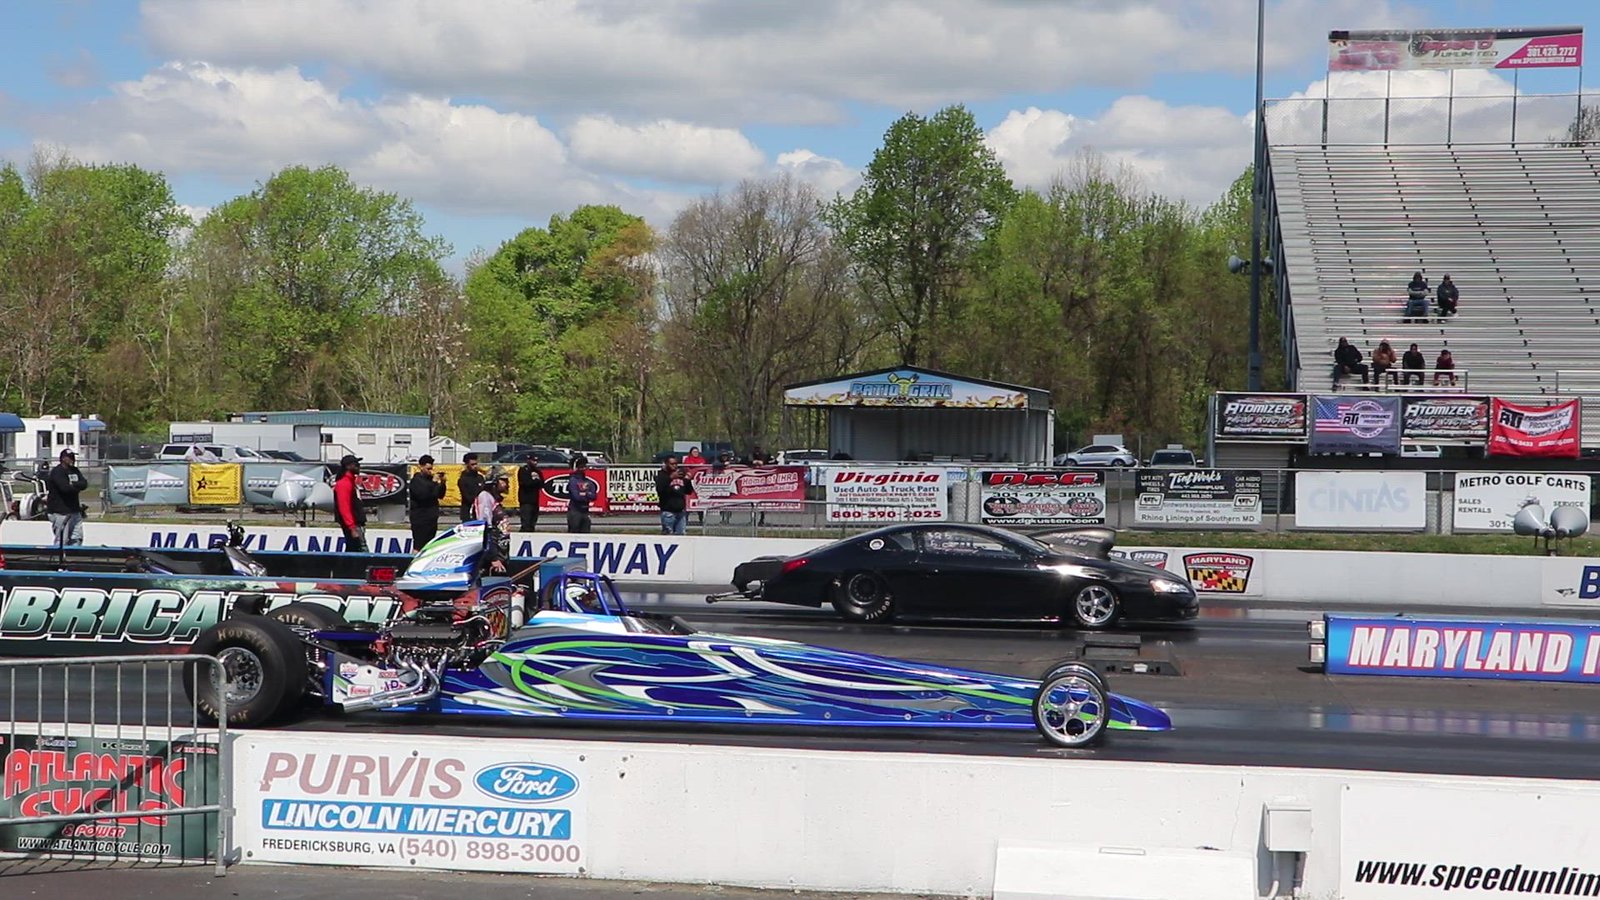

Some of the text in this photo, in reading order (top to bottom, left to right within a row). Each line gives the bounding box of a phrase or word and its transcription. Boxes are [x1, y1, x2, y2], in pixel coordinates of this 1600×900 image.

[851, 383, 953, 399] PATIO GRILL
[1225, 402, 1292, 415] ATOMIZER
[1404, 404, 1475, 417] ATOMIZER
[1343, 412, 1360, 425] ATI
[1499, 408, 1524, 429] ATI
[609, 470, 658, 482] MARYLAN
[778, 472, 798, 483] IHRA
[833, 472, 940, 486] Virginia
[1460, 475, 1586, 491] METRO GOLF CARTS
[113, 479, 184, 490] PRO MOD
[609, 483, 656, 492] PIPE & SUPP
[1308, 480, 1411, 513] CINTAS
[609, 505, 660, 513] www.mdpipe.co
[832, 510, 942, 519] 800-390-2025
[1141, 513, 1163, 521] Rhino
[1166, 513, 1195, 522] Linings
[517, 541, 679, 575] ACEWAY
[1135, 552, 1165, 560] IHRA
[1190, 557, 1247, 566] MARYLAND
[1348, 627, 1573, 674] MARYLAND
[4, 749, 187, 808] ATLANTIC
[260, 751, 560, 799] PURVIS Ford
[268, 801, 564, 838] LINCOLN MERCURY
[62, 824, 126, 838] & POWER
[18, 836, 171, 855] WWW.ATLANTICCYCLE.COM
[262, 836, 581, 864] FREDERICKSBURG, VA (540) 898-3000
